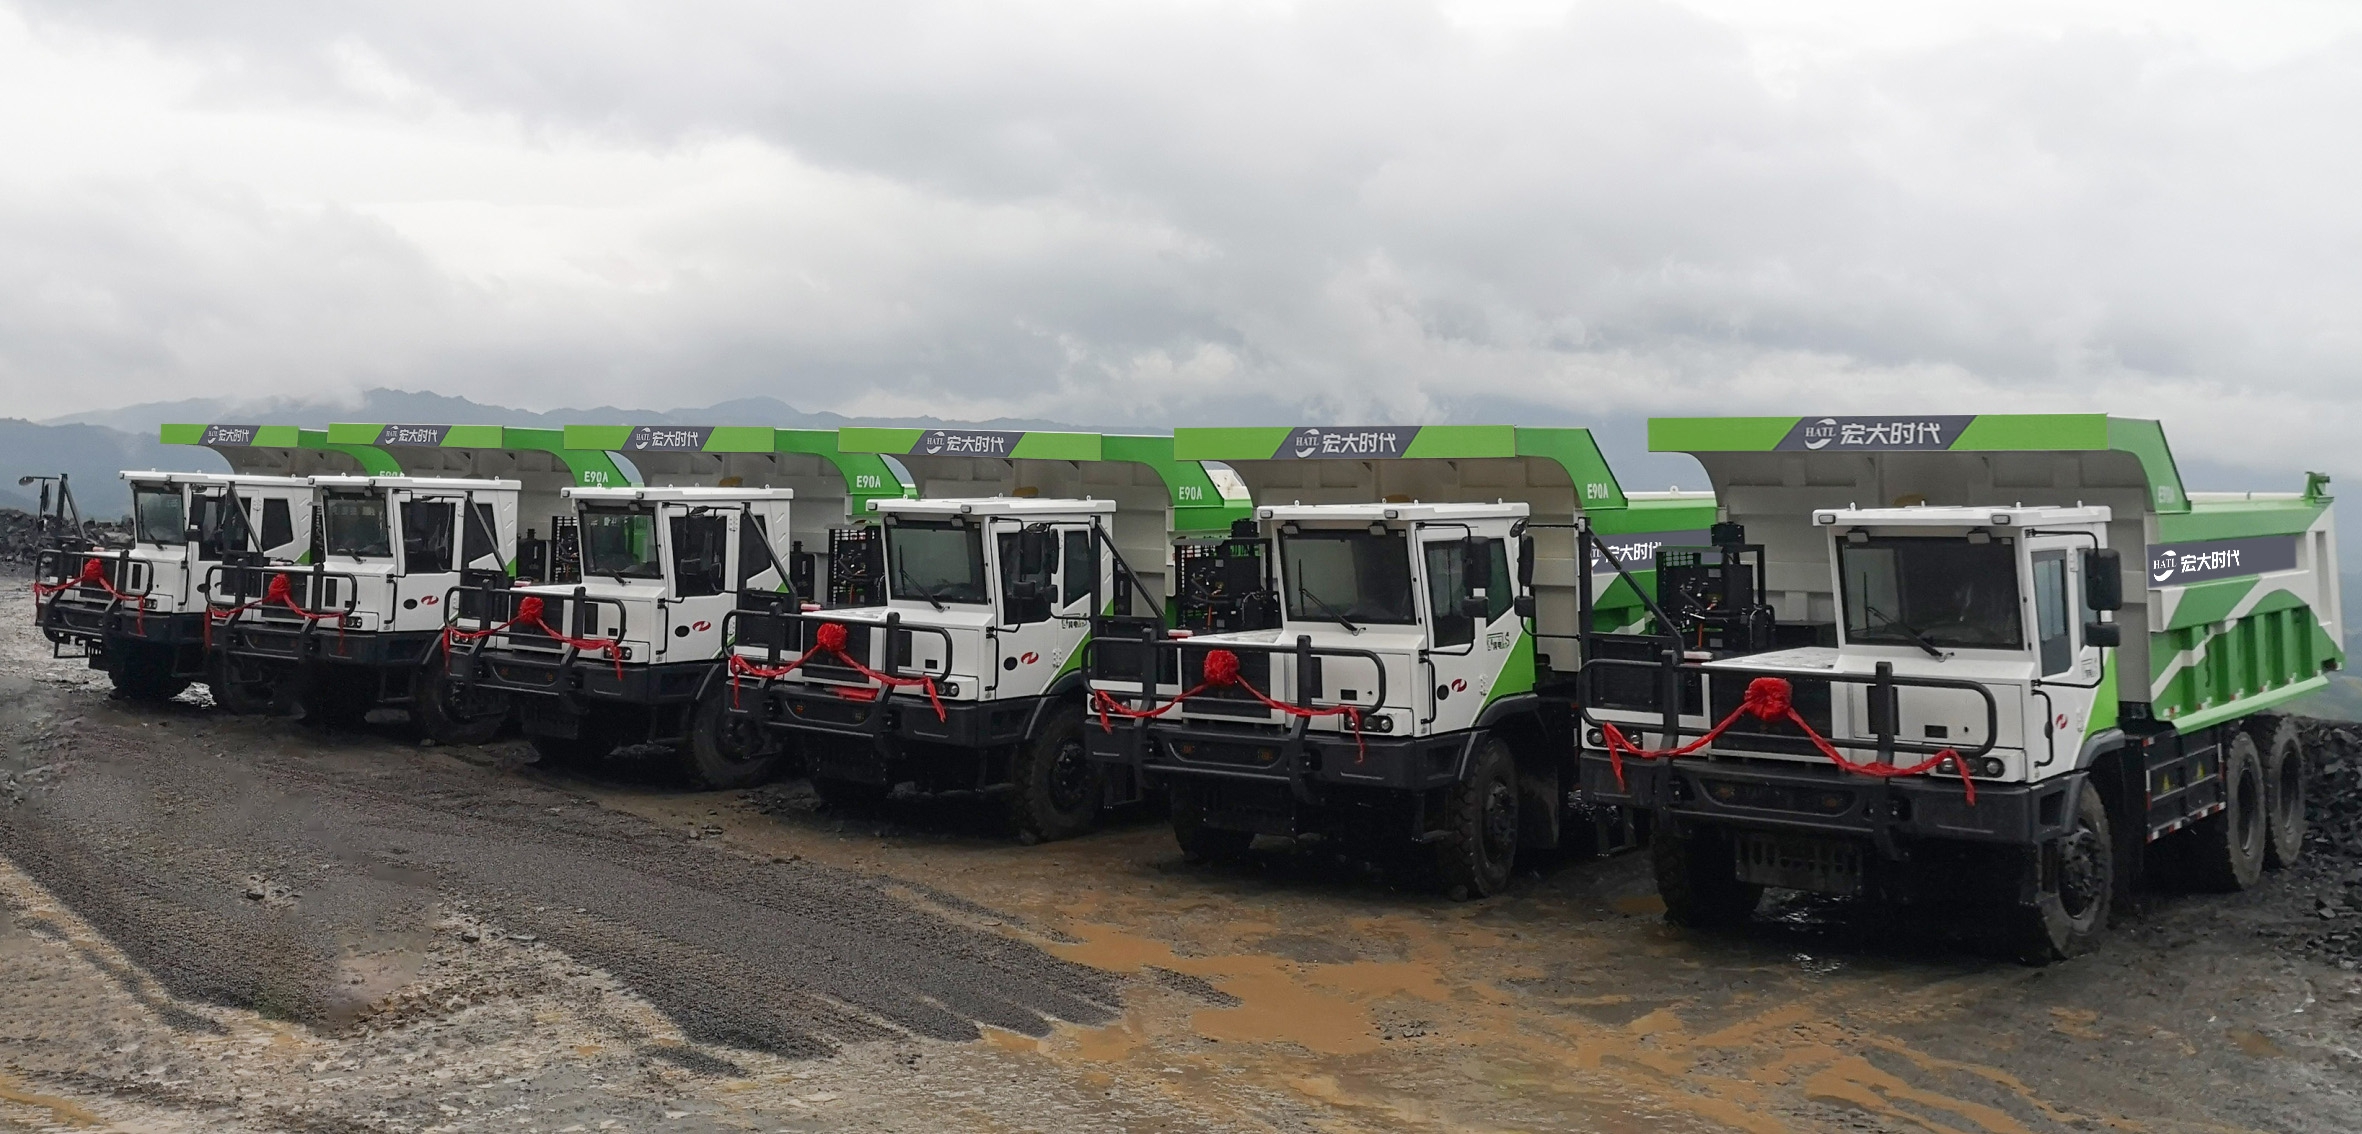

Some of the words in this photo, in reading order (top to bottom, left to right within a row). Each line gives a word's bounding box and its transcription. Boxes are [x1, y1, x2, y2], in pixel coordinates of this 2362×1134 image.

[218, 429, 250, 442] 宏大时代
[398, 429, 438, 443] 宏大时代
[636, 433, 650, 441] HATL
[1805, 427, 1837, 437] HATL
[1840, 422, 1941, 445] 宏大时代
[651, 431, 699, 447] 宏大时代
[927, 437, 945, 445] HATL
[946, 435, 1004, 453] 宏大时代
[1296, 436, 1319, 447] HATL
[1322, 432, 1396, 454] 宏大时代
[584, 471, 609, 483] E90A
[856, 475, 881, 488] E90A
[1178, 486, 1203, 501] E90A
[1587, 483, 1609, 500] E90A
[2153, 557, 2177, 570] HATL
[2180, 550, 2240, 574] 宏大时代
